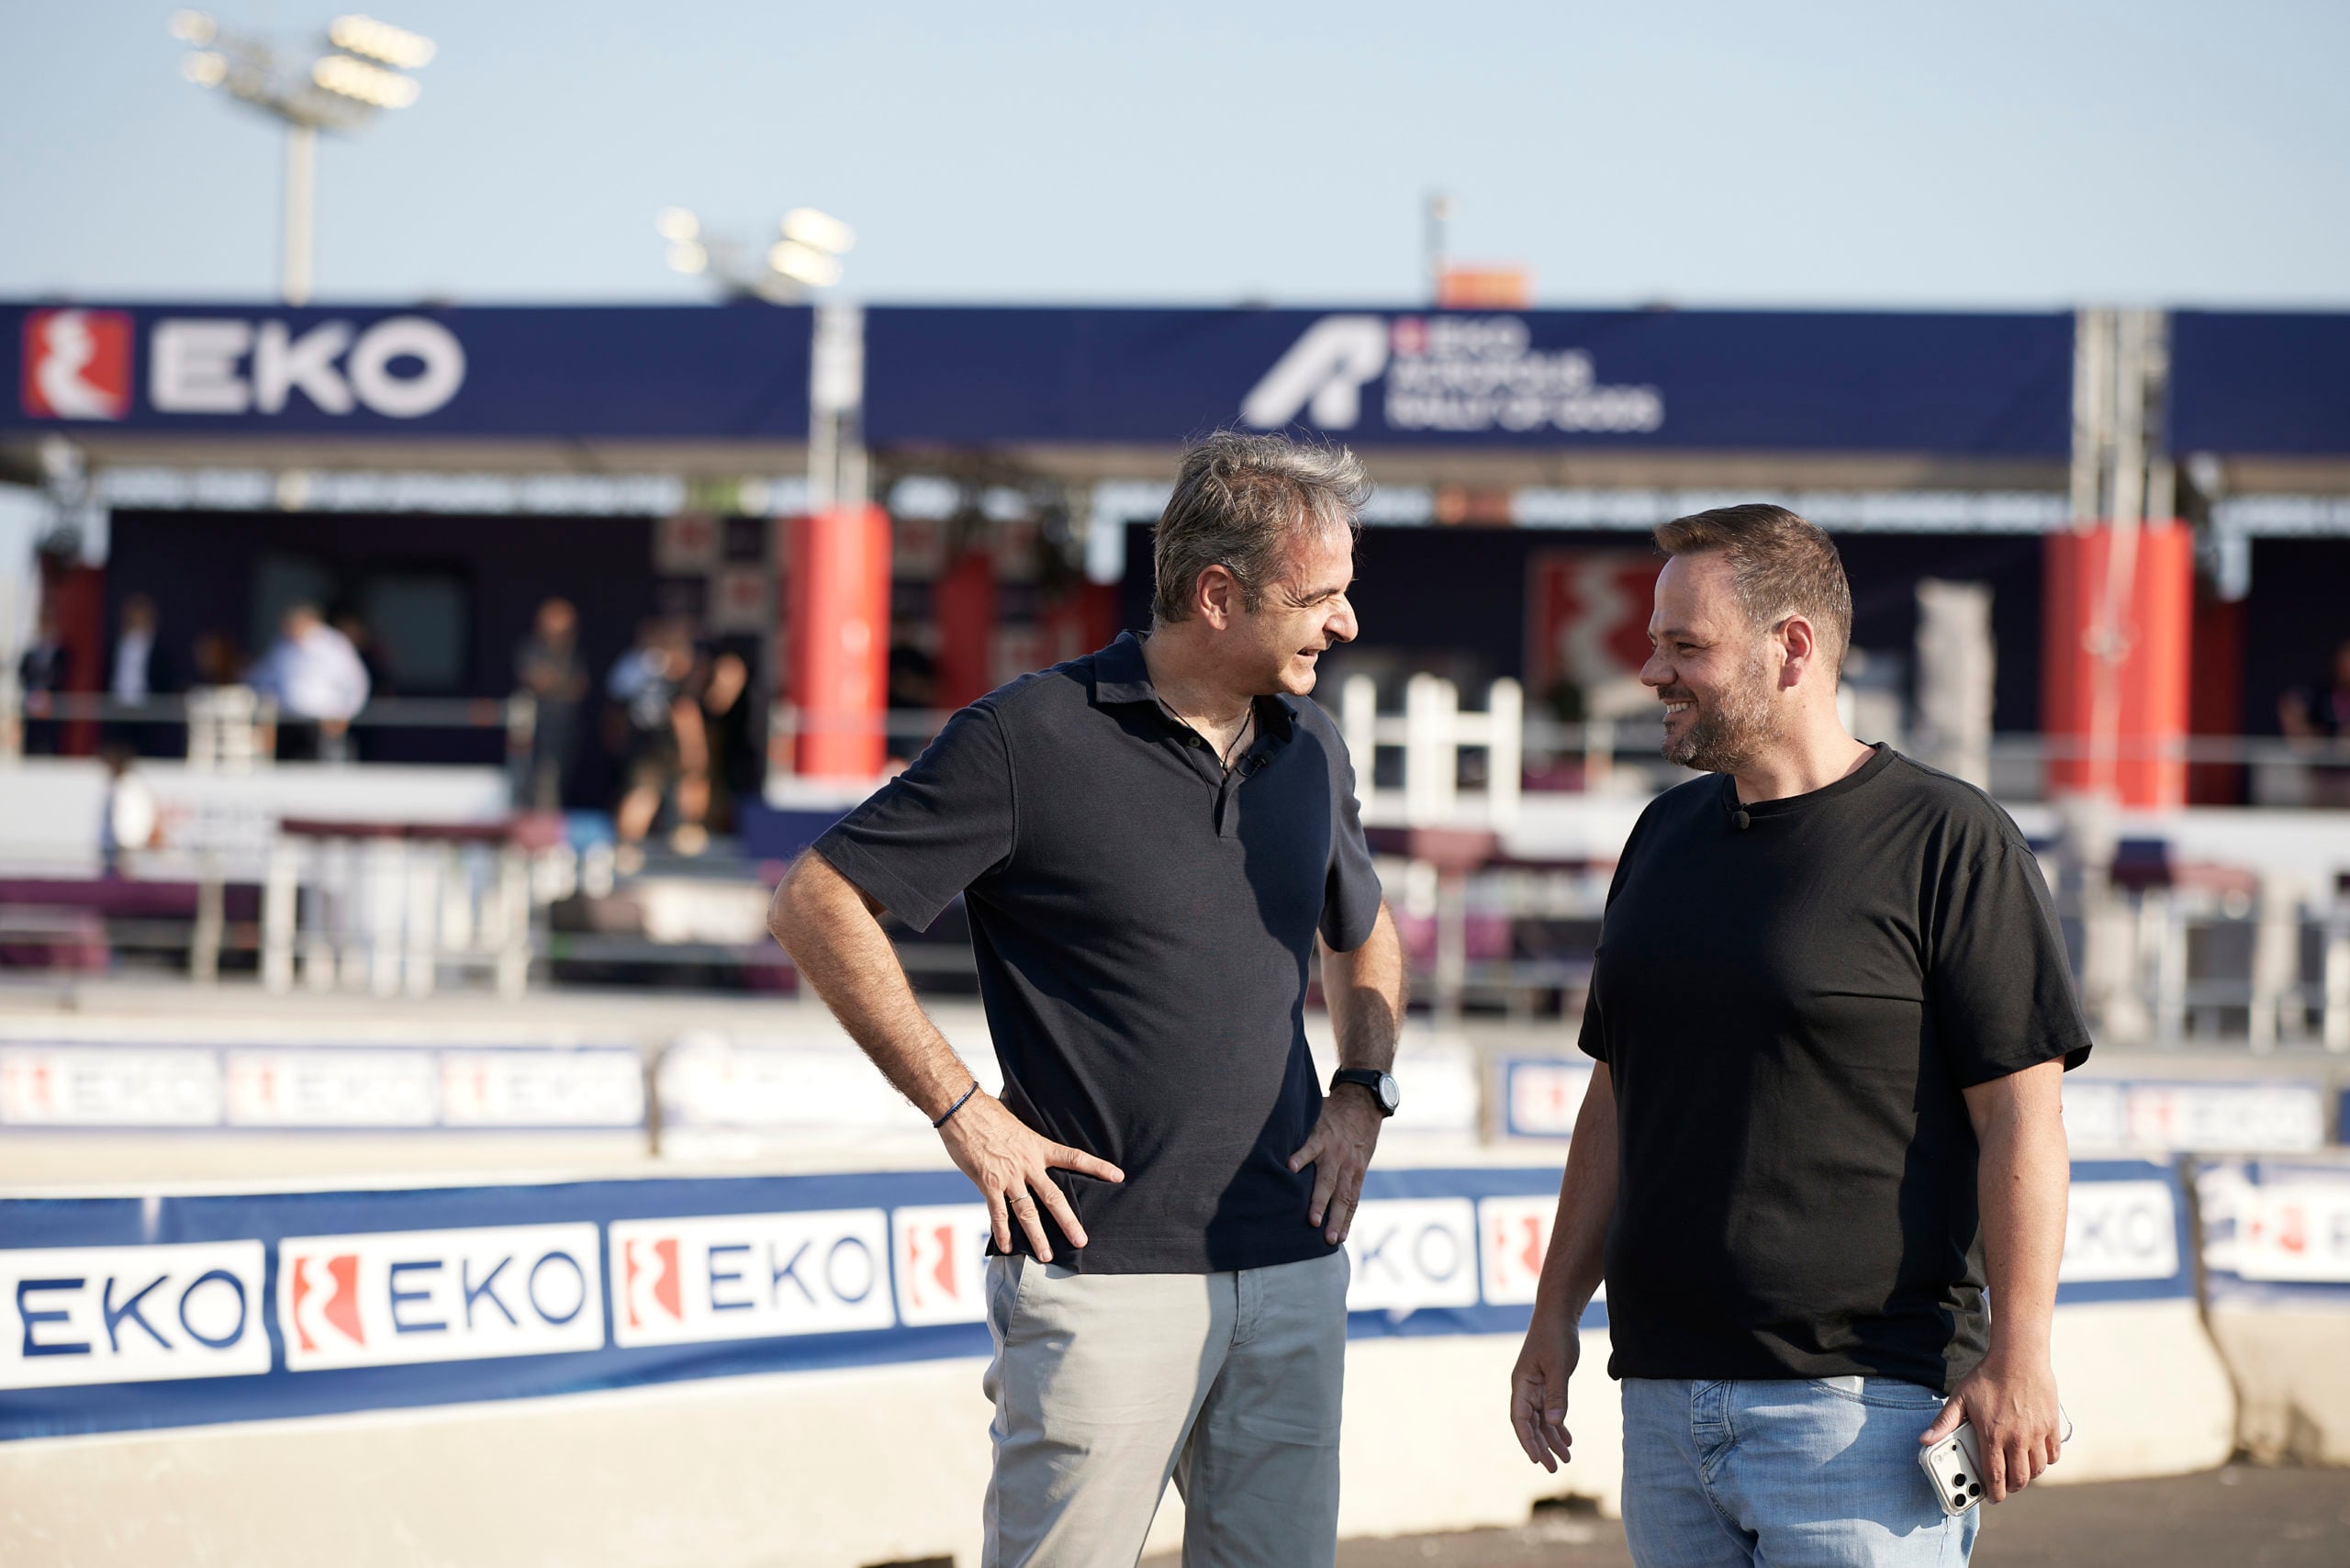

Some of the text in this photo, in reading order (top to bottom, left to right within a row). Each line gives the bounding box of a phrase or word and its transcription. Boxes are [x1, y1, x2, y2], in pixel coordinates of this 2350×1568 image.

[150, 316, 466, 418] EKO
[388, 1250, 586, 1335] EKO
[707, 1236, 875, 1312] EKO
[1353, 1221, 1460, 1282] KO
[17, 1269, 247, 1357] EKO
